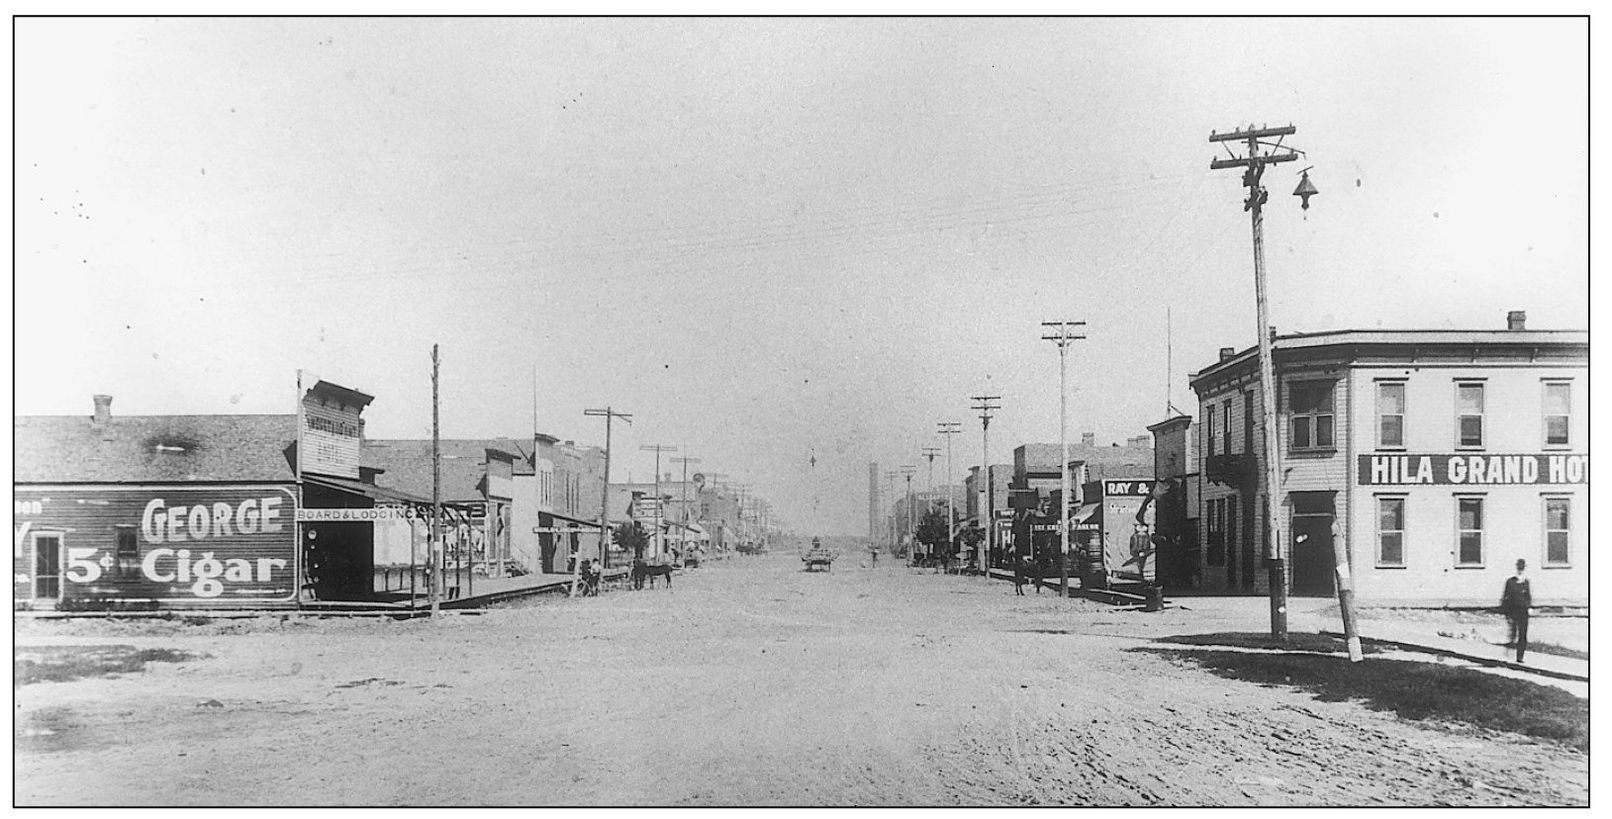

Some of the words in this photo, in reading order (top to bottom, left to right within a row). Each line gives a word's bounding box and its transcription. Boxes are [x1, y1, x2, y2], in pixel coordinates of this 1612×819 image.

[1107, 482, 1132, 494] RAY
[1137, 482, 1150, 494] &
[1371, 456, 1434, 484] HILA
[1447, 456, 1539, 484] GRAND
[1548, 456, 1588, 484] HO
[142, 497, 282, 543] GEORGE
[141, 548, 287, 597] Cigar
